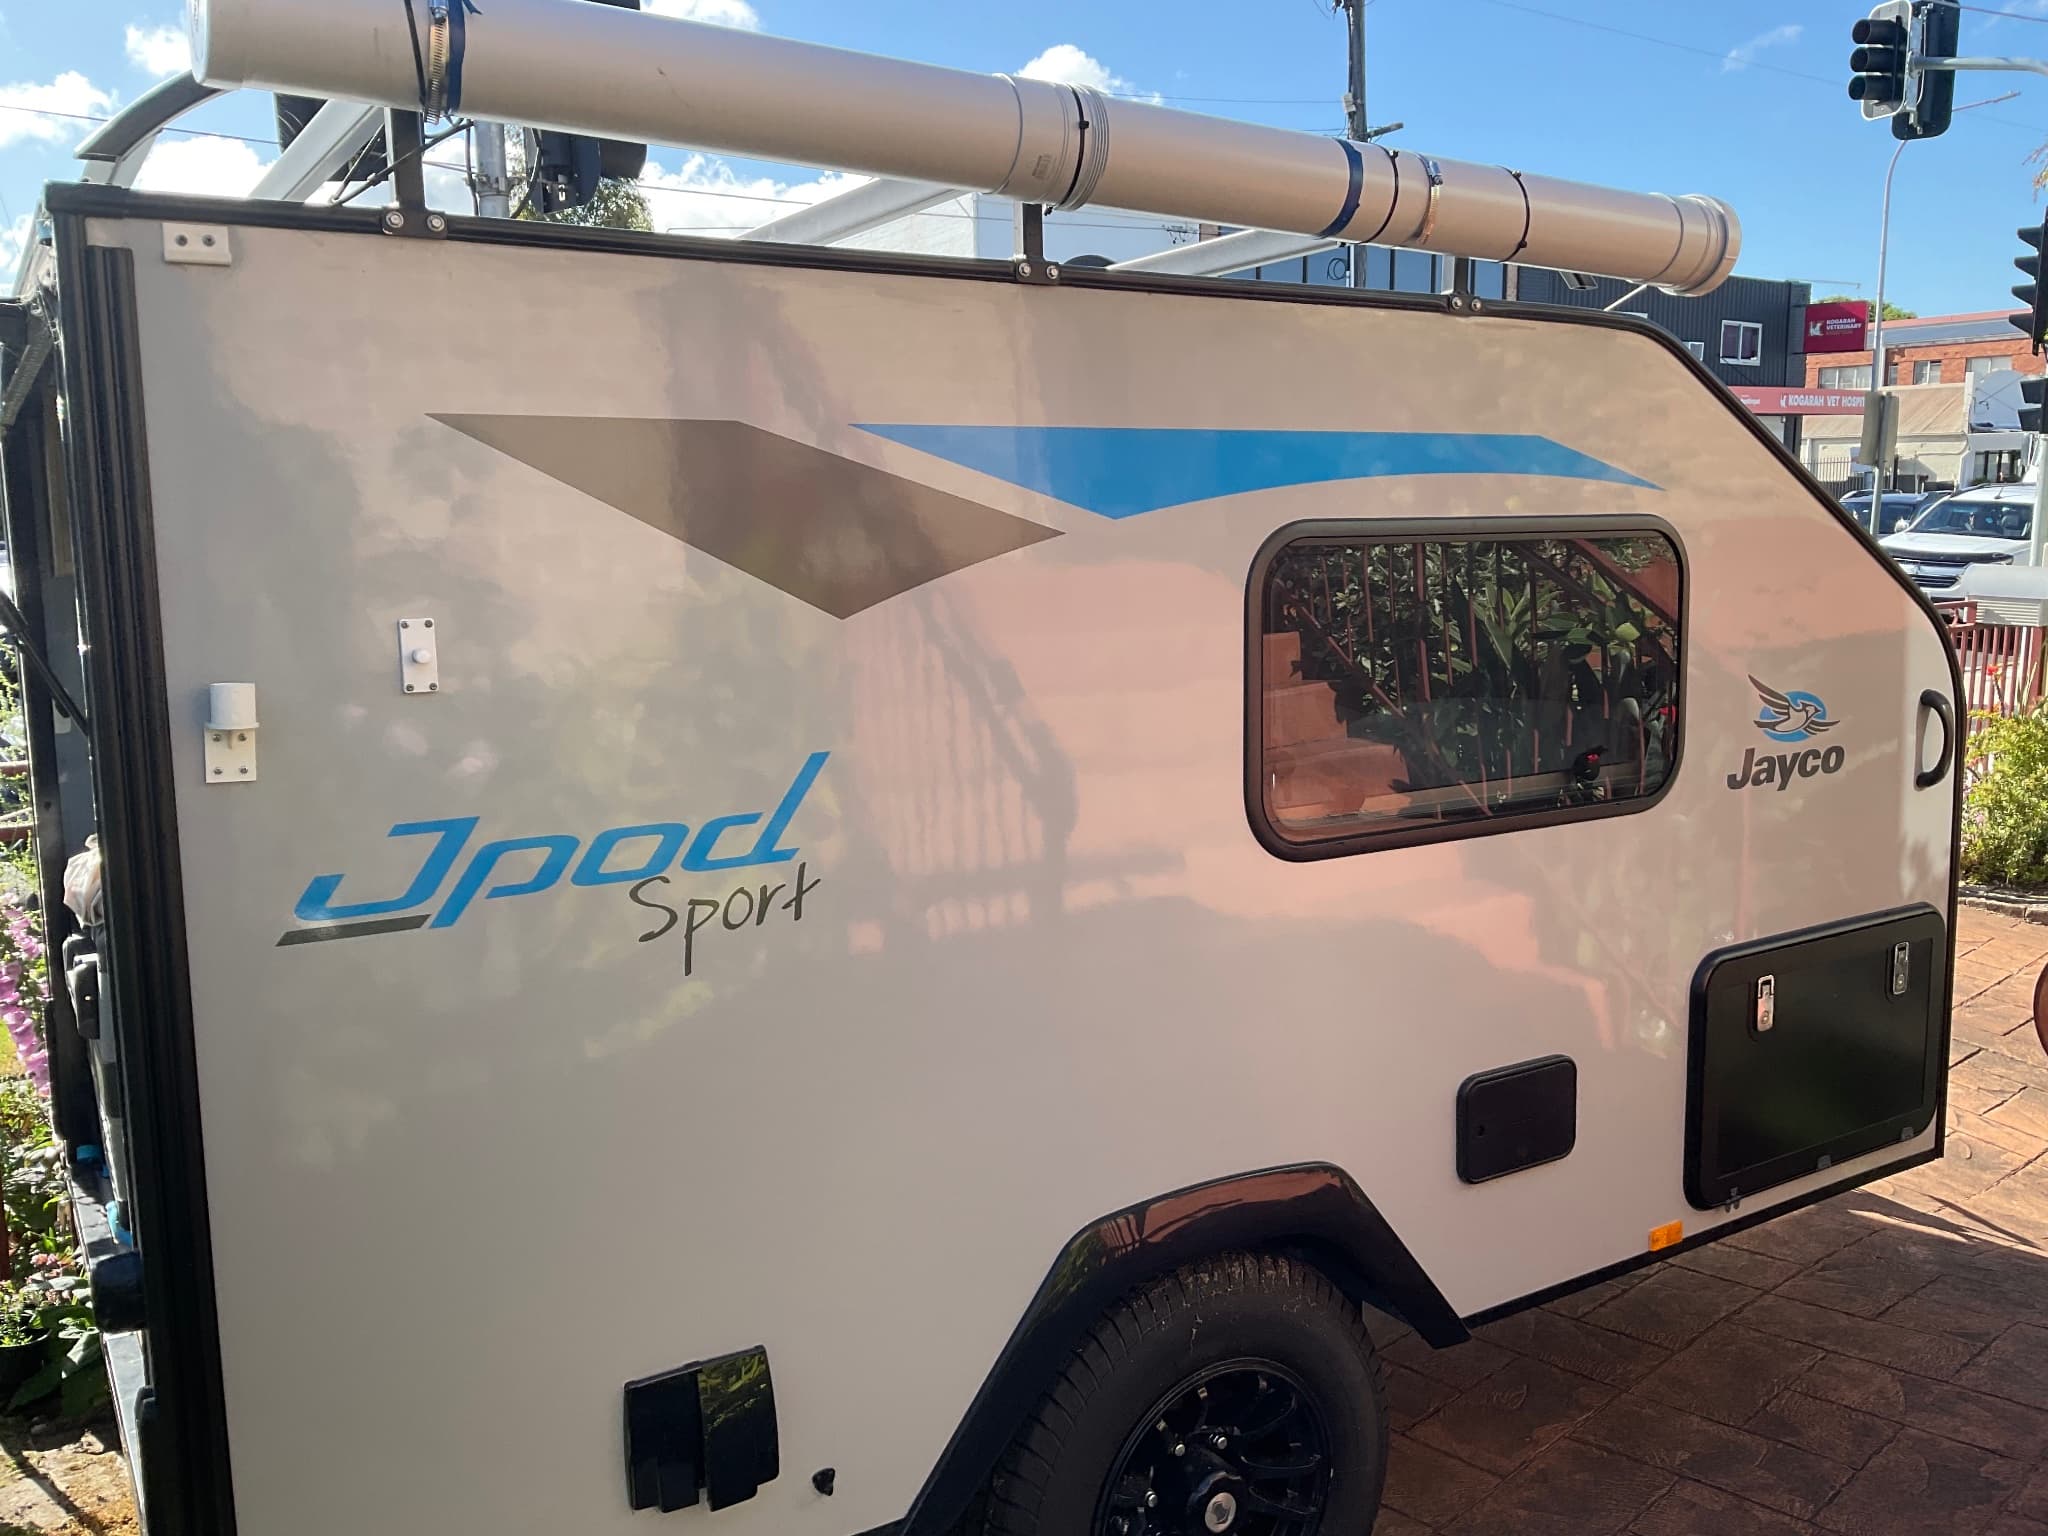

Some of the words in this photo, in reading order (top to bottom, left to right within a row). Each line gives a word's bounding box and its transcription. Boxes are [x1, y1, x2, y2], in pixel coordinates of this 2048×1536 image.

[1788, 394, 1824, 406] KOGARAH
[1826, 395, 1840, 407] VET
[1726, 745, 1845, 791] Jayco
[293, 751, 831, 928] Jpod
[628, 862, 821, 977] Sport
